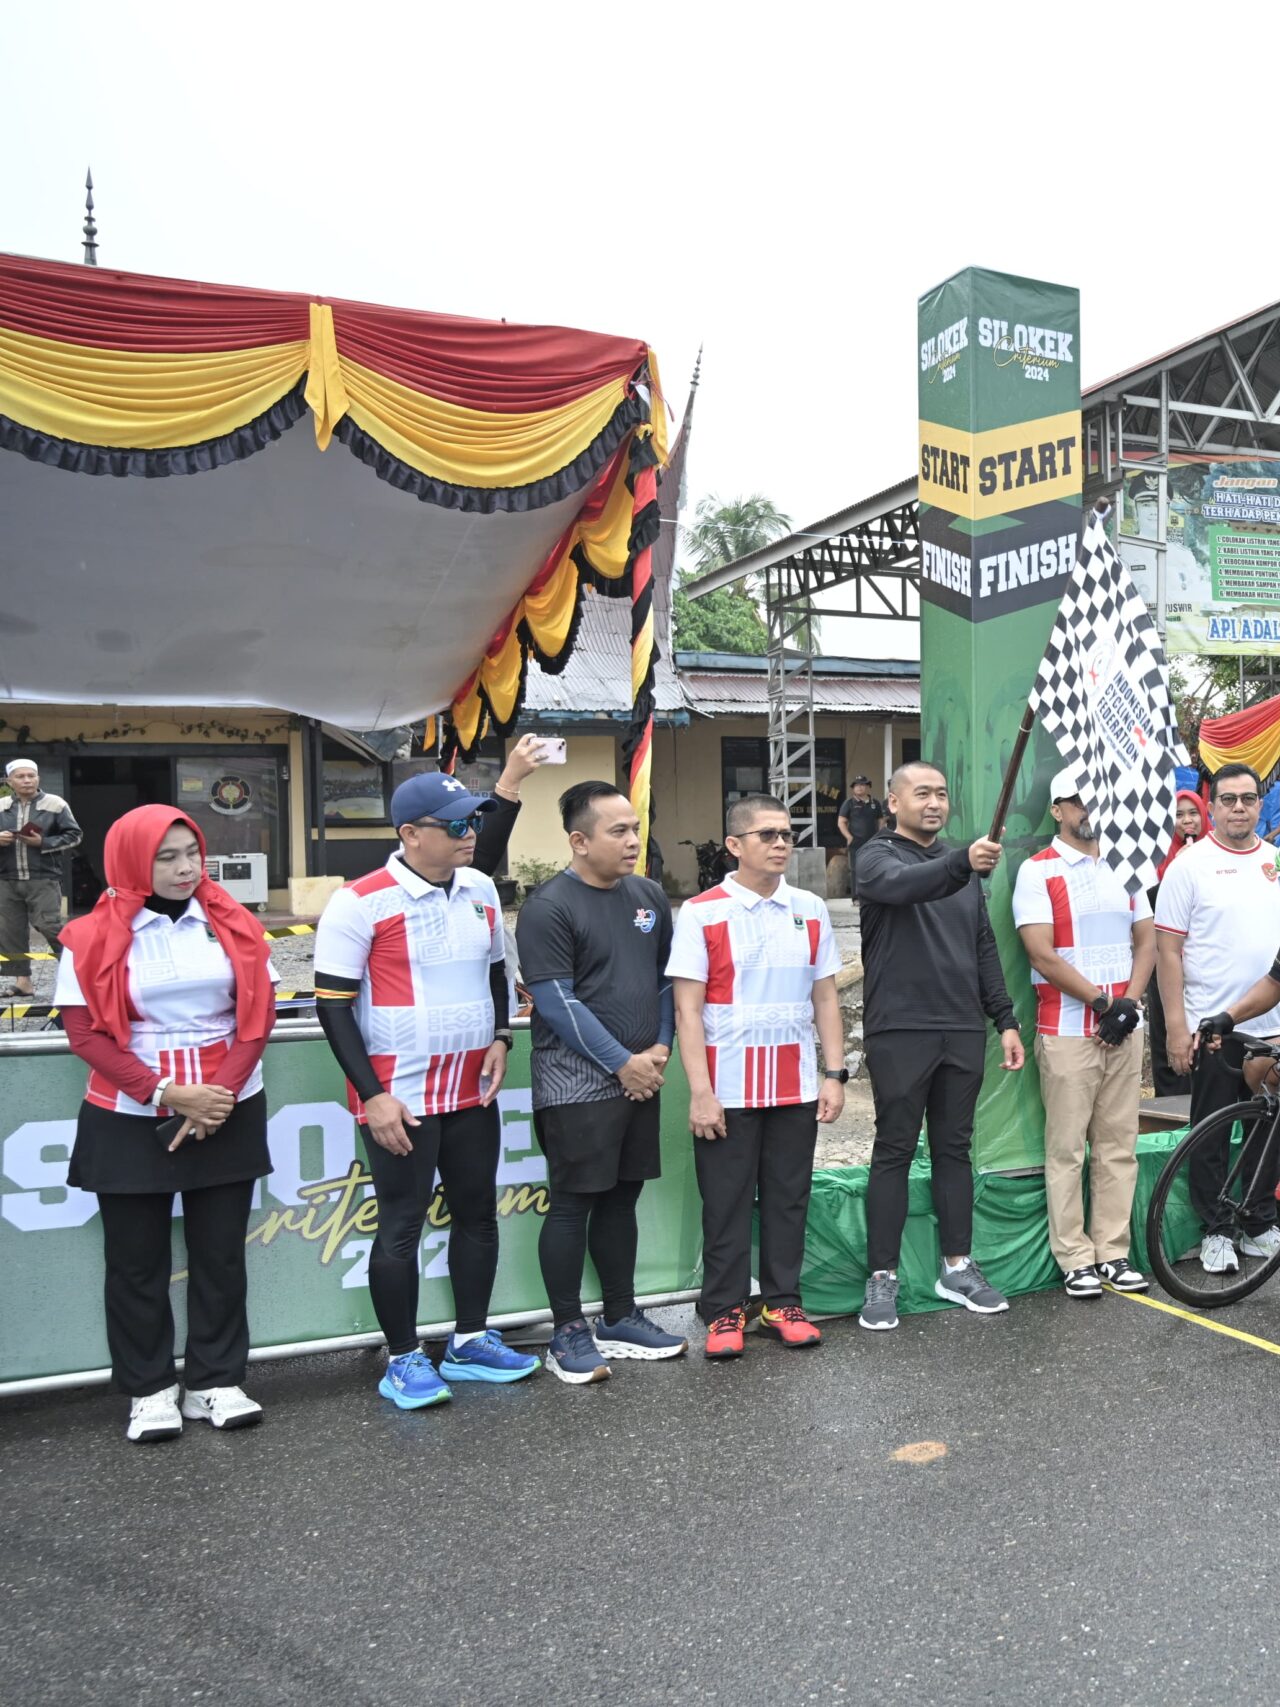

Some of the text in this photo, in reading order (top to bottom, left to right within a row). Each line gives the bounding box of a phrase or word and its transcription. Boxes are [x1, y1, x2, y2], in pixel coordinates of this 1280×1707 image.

[921, 316, 969, 371] SILOKEK
[978, 316, 1074, 363] SILOKEK
[993, 335, 1060, 369] Criterium
[1025, 365, 1050, 382] 2024
[921, 443, 970, 494] START
[979, 436, 1076, 496] START
[1204, 506, 1261, 521] TERHADAP
[1215, 492, 1271, 507] HATI-HATI
[922, 540, 972, 598] FINISH
[979, 532, 1077, 599] FINISH
[1210, 617, 1237, 639] API
[1104, 683, 1136, 733] CYCLING
[1113, 670, 1155, 738] INDONESIAN
[1097, 696, 1140, 763] FEDERATION
